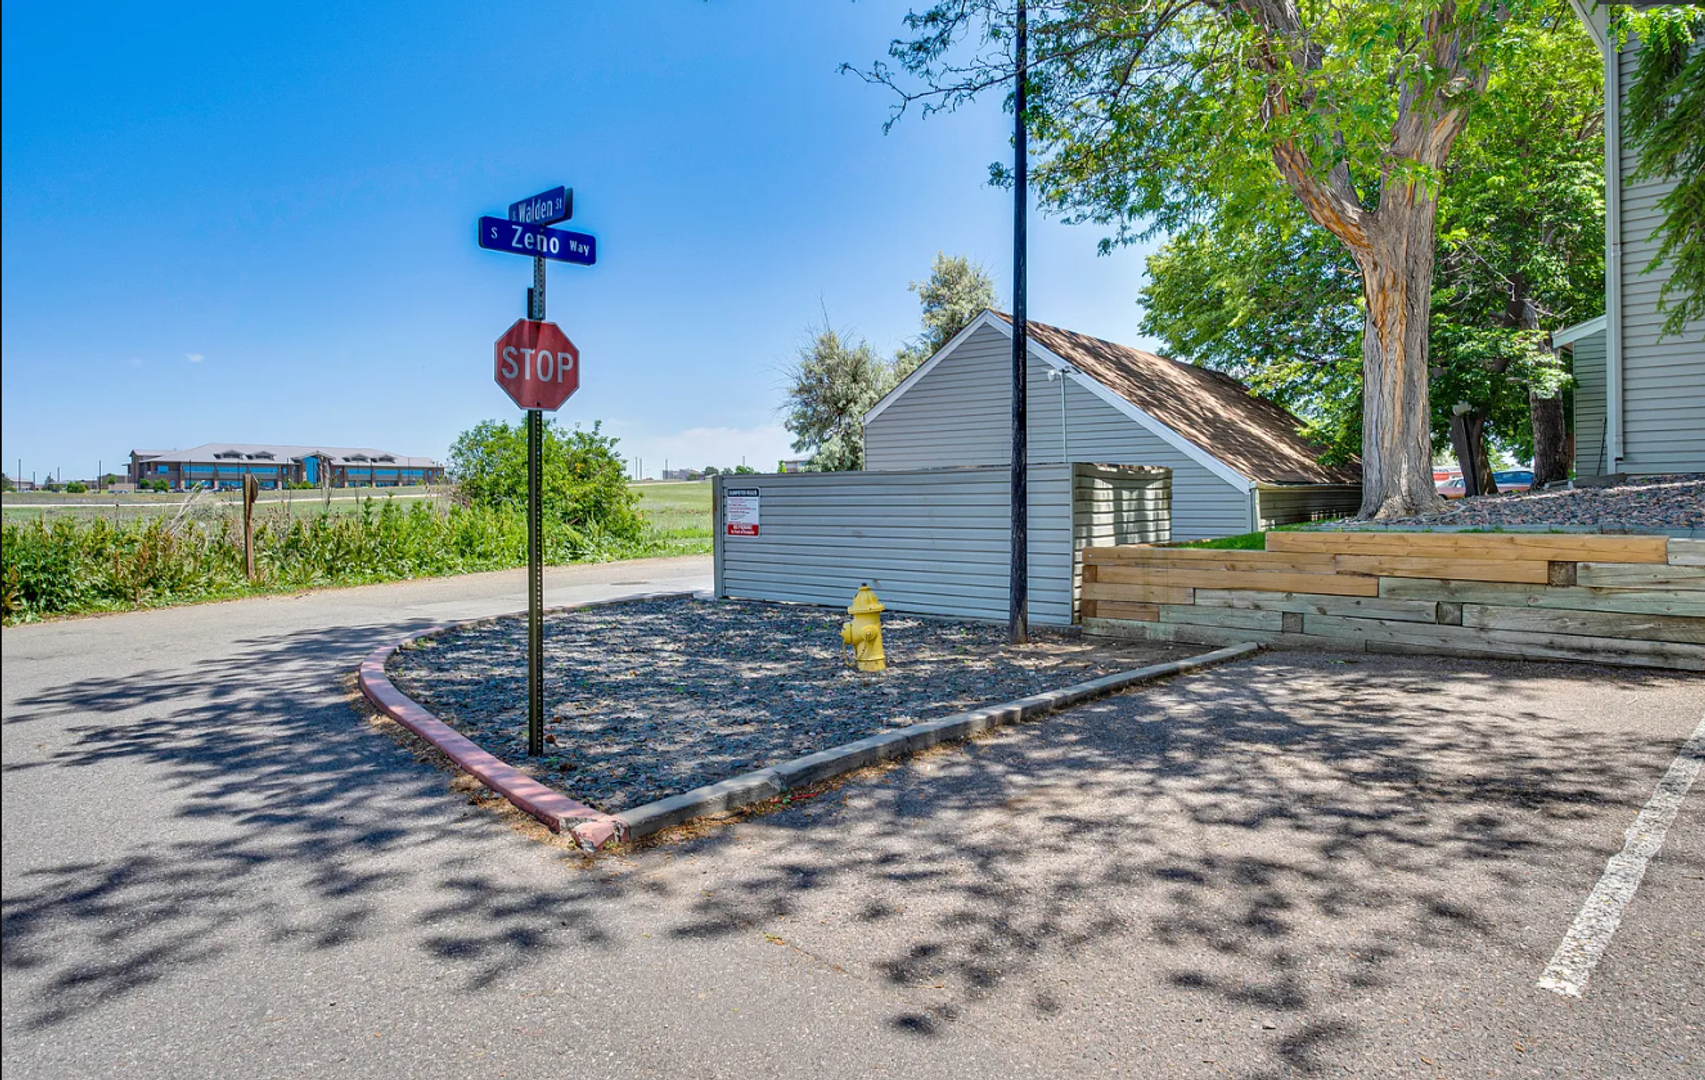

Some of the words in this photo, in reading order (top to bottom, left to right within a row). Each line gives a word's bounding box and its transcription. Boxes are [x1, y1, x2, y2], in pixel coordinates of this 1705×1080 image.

[519, 199, 553, 223] Walden
[491, 227, 498, 239] S
[511, 225, 560, 254] Zeno
[569, 239, 590, 256] Way
[501, 345, 574, 383] STOP
